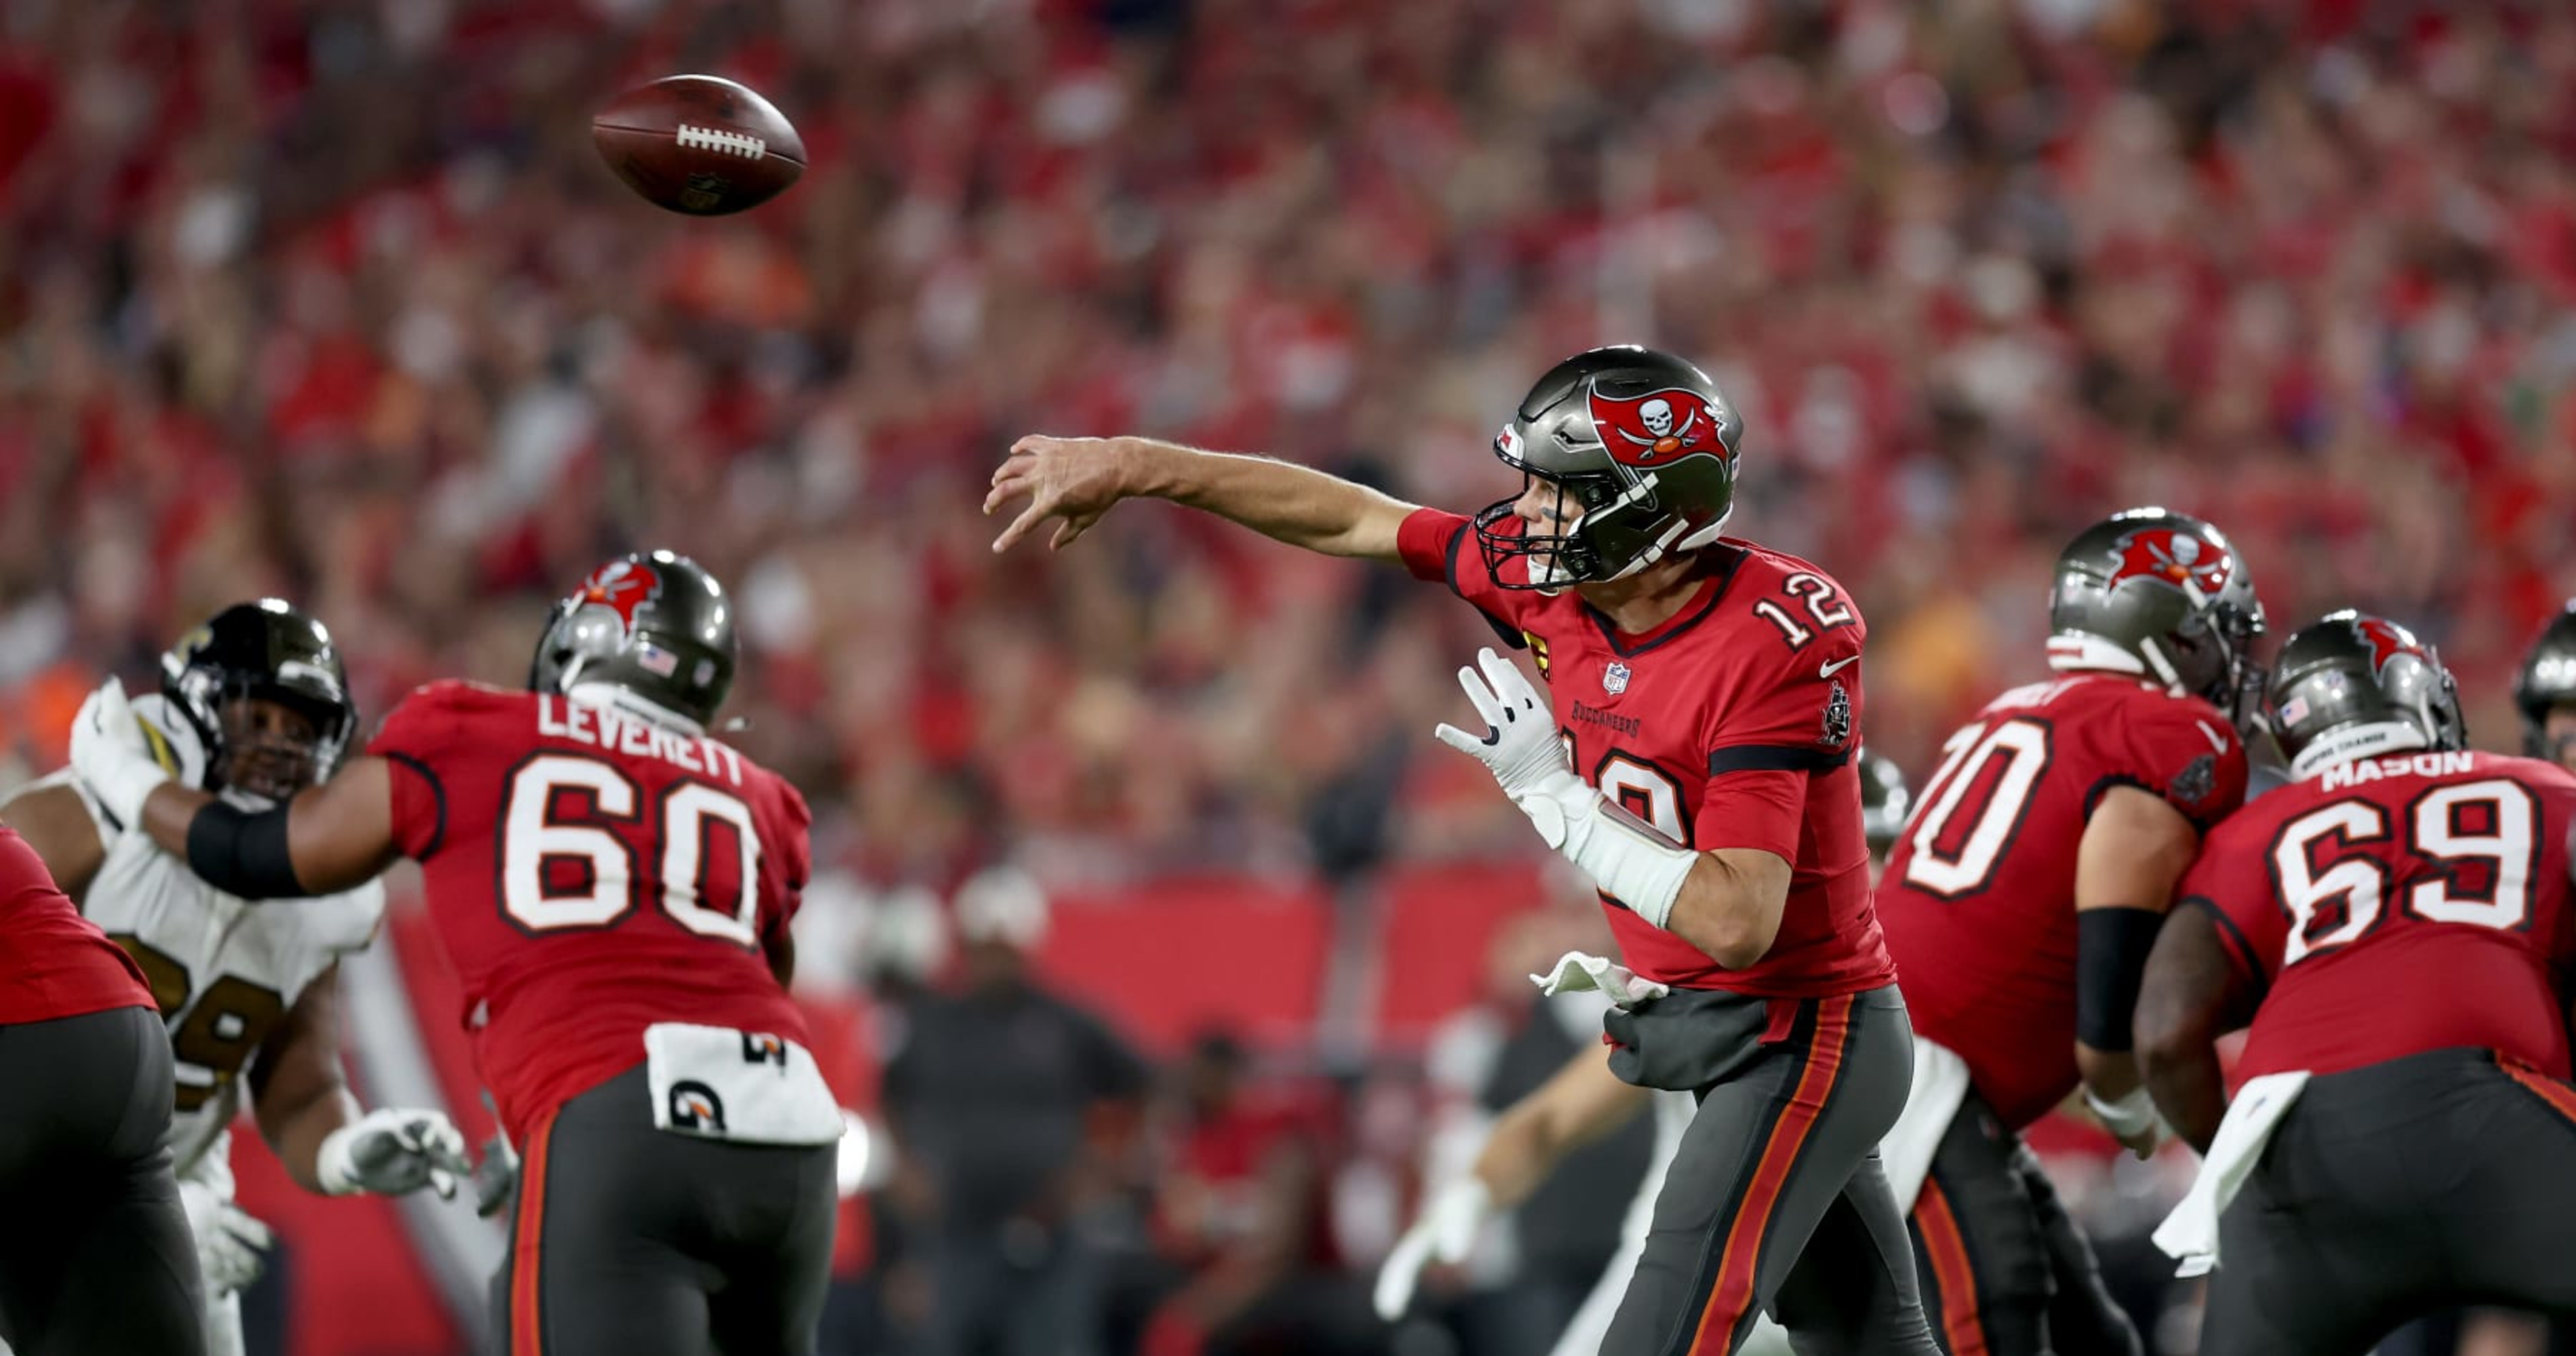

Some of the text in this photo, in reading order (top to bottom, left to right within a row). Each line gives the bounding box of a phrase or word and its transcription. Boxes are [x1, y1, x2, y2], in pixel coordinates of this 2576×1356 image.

[1752, 572, 1856, 654] 12
[538, 694, 742, 787] LEVERETT
[1571, 700, 1641, 739] BUCCANEERS
[2322, 744, 2474, 793] MASON
[496, 749, 761, 953] 60
[2266, 778, 2543, 965] 69
